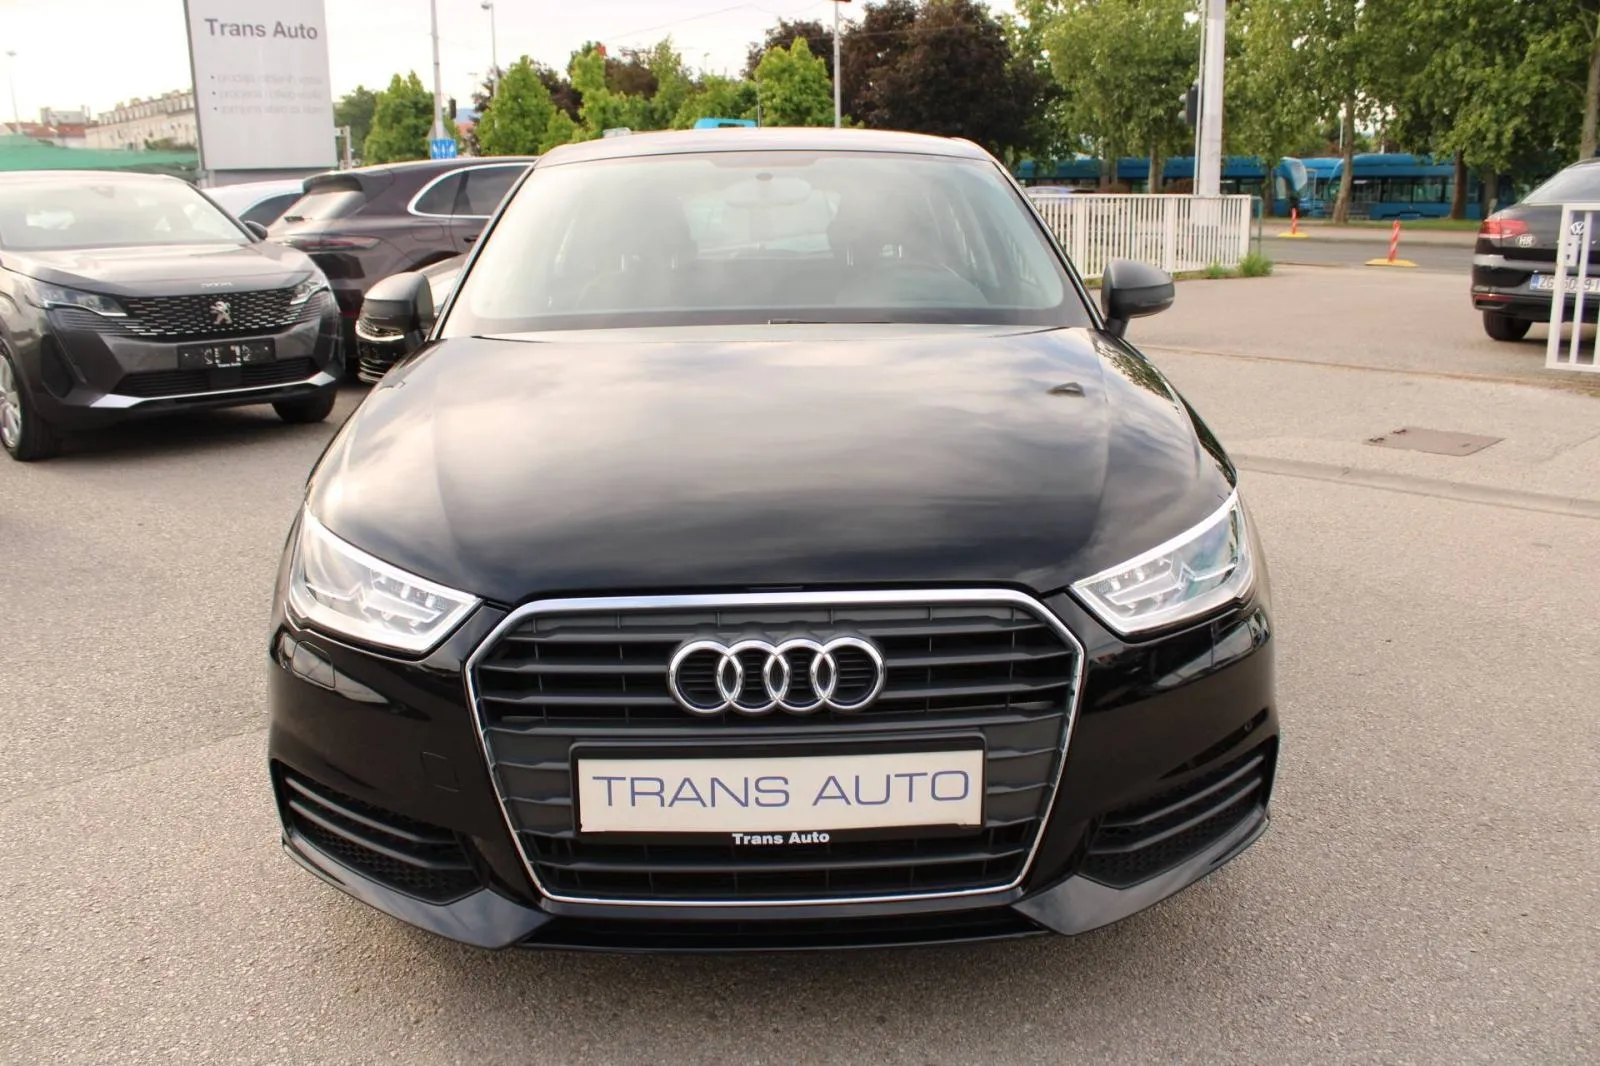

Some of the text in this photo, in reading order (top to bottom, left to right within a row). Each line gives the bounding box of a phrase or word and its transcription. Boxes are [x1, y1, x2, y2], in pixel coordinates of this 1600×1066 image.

[204, 18, 318, 40] Trans Auto
[592, 770, 969, 808] TRANS AUTO
[732, 831, 830, 846] Trans Auto
